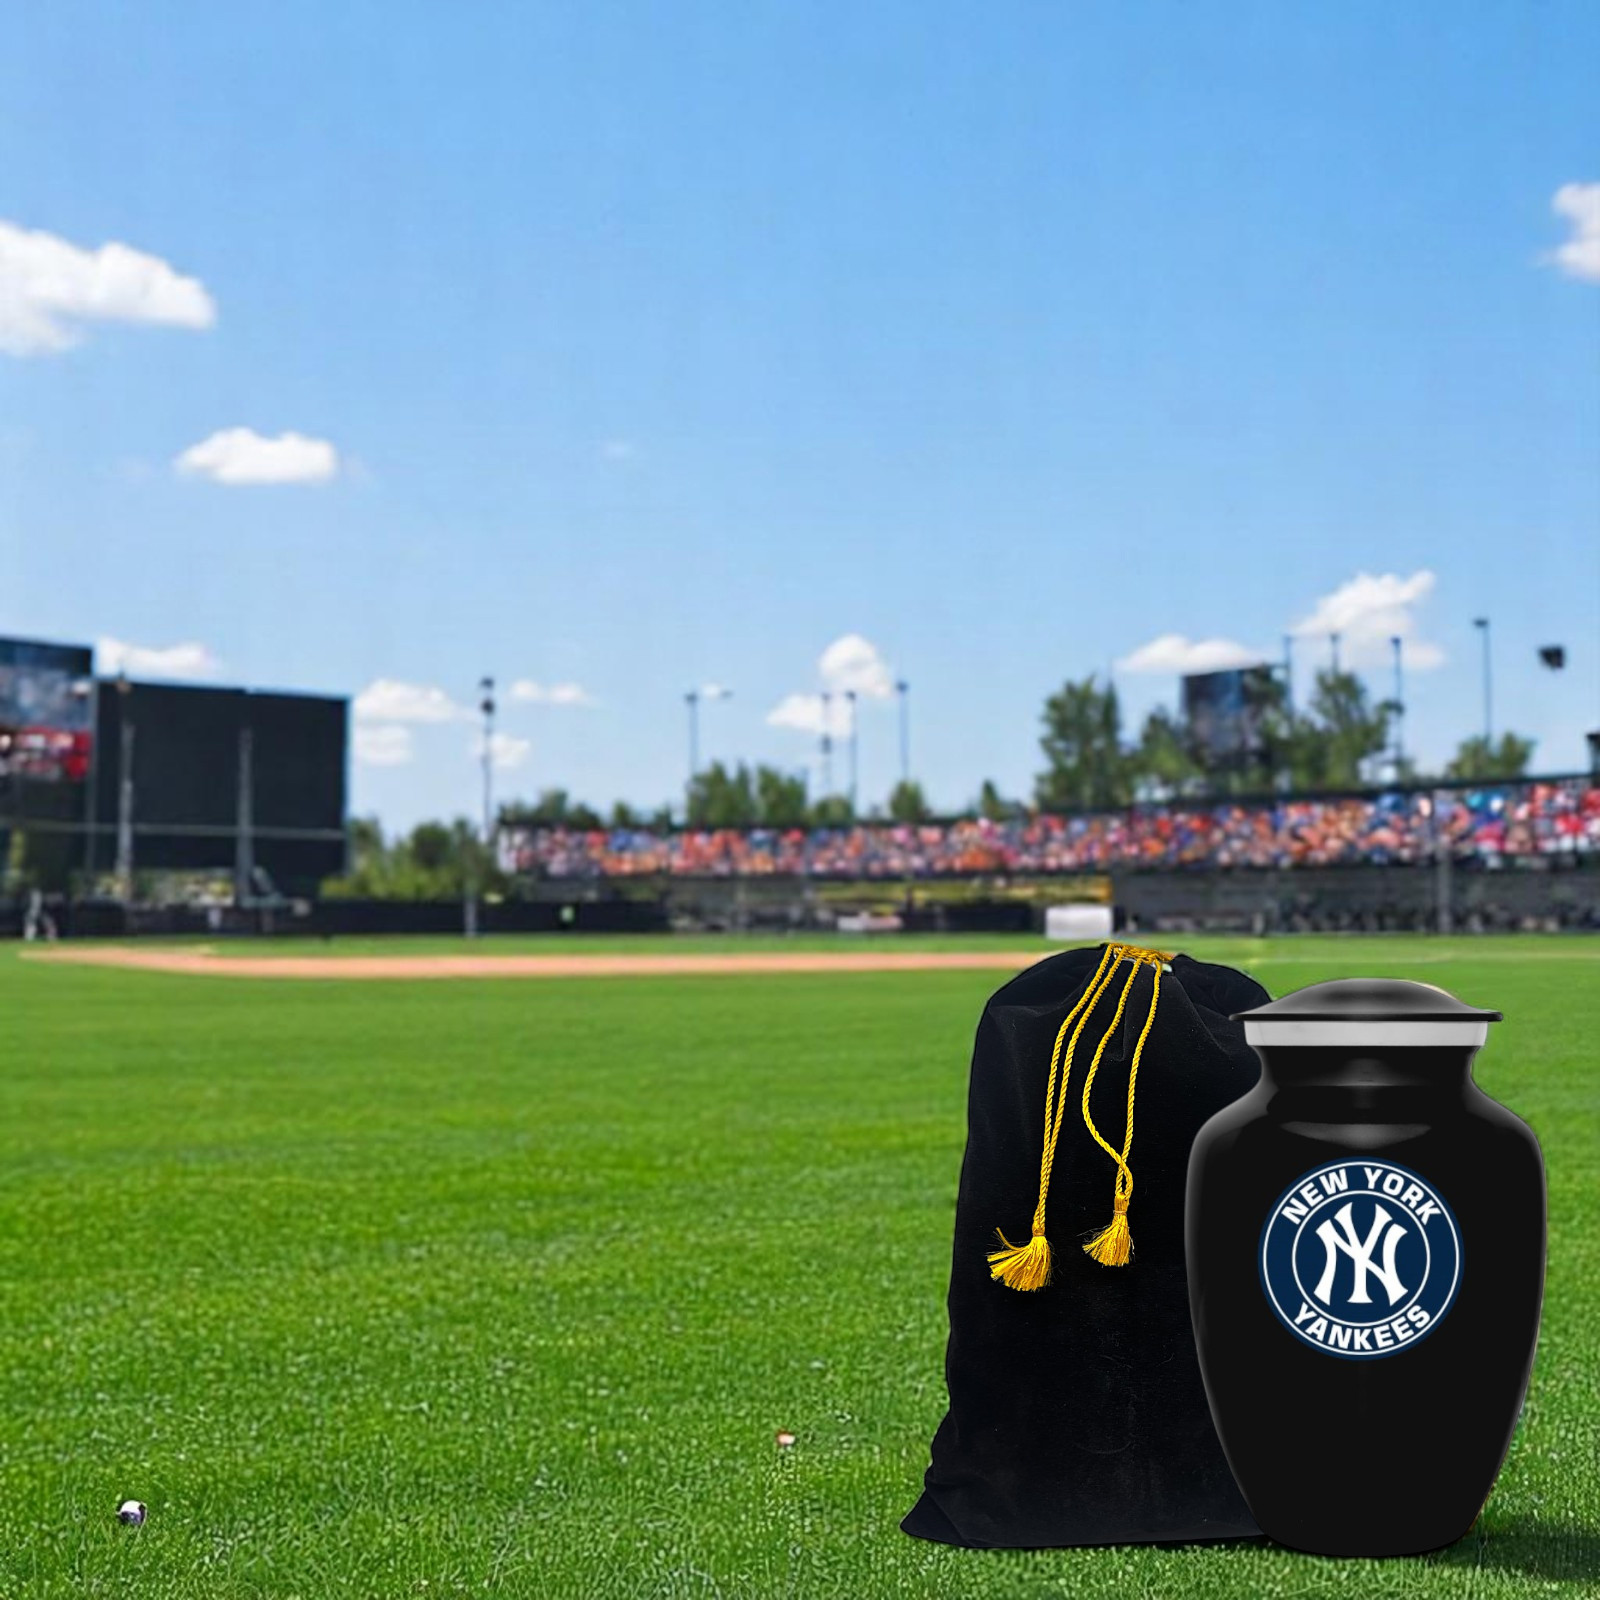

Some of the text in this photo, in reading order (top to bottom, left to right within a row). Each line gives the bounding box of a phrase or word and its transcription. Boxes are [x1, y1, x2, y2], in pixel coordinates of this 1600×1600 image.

[1281, 1167, 1441, 1225] NEW YORK
[1293, 1301, 1431, 1350] YANKEES
